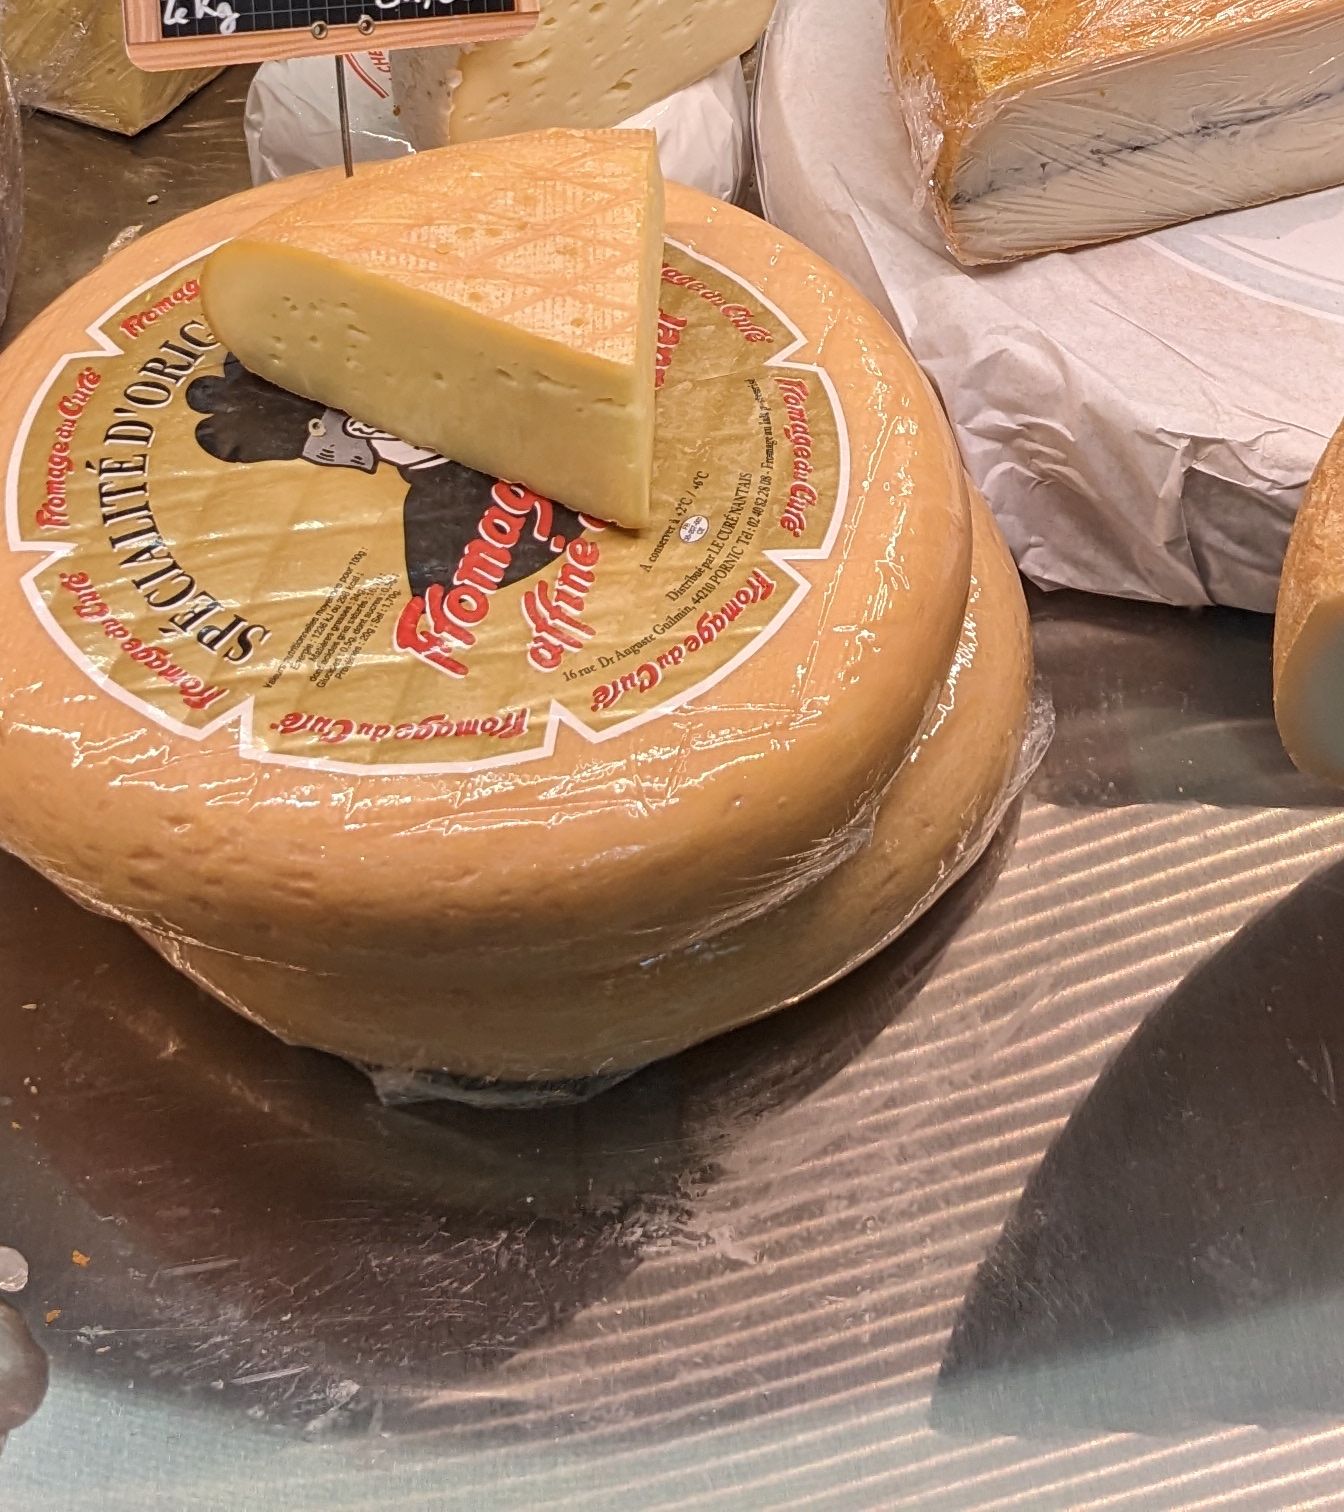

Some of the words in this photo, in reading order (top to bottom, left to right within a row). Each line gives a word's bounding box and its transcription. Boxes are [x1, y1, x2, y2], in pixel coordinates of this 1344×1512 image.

[120, 279, 202, 339] Fromag
[59, 366, 102, 420] Curé
[56, 416, 77, 443] du
[773, 377, 812, 461] Fromage
[35, 441, 76, 530] Fromage
[730, 472, 754, 515] NANTAIS
[780, 479, 818, 539] Curé
[648, 526, 677, 565] conserver
[707, 539, 723, 556] LE
[717, 513, 740, 542] CURÉ
[85, 454, 273, 666] SPÉCIALITÉ
[393, 477, 553, 679] Fromag
[665, 566, 706, 603] Distribué
[703, 553, 716, 573] par
[60, 571, 110, 622] Curé
[562, 670, 578, 683] 16
[578, 664, 597, 678] rue
[597, 655, 616, 670] Dr
[615, 635, 657, 662] Auguste
[691, 583, 717, 606] 44210
[710, 544, 745, 586] PORNIC
[682, 566, 778, 654] Fromage
[119, 635, 229, 710] Fromage
[591, 661, 662, 713] Curé
[270, 710, 358, 744] Curé
[356, 720, 392, 742] du
[394, 706, 531, 742] Fromage
